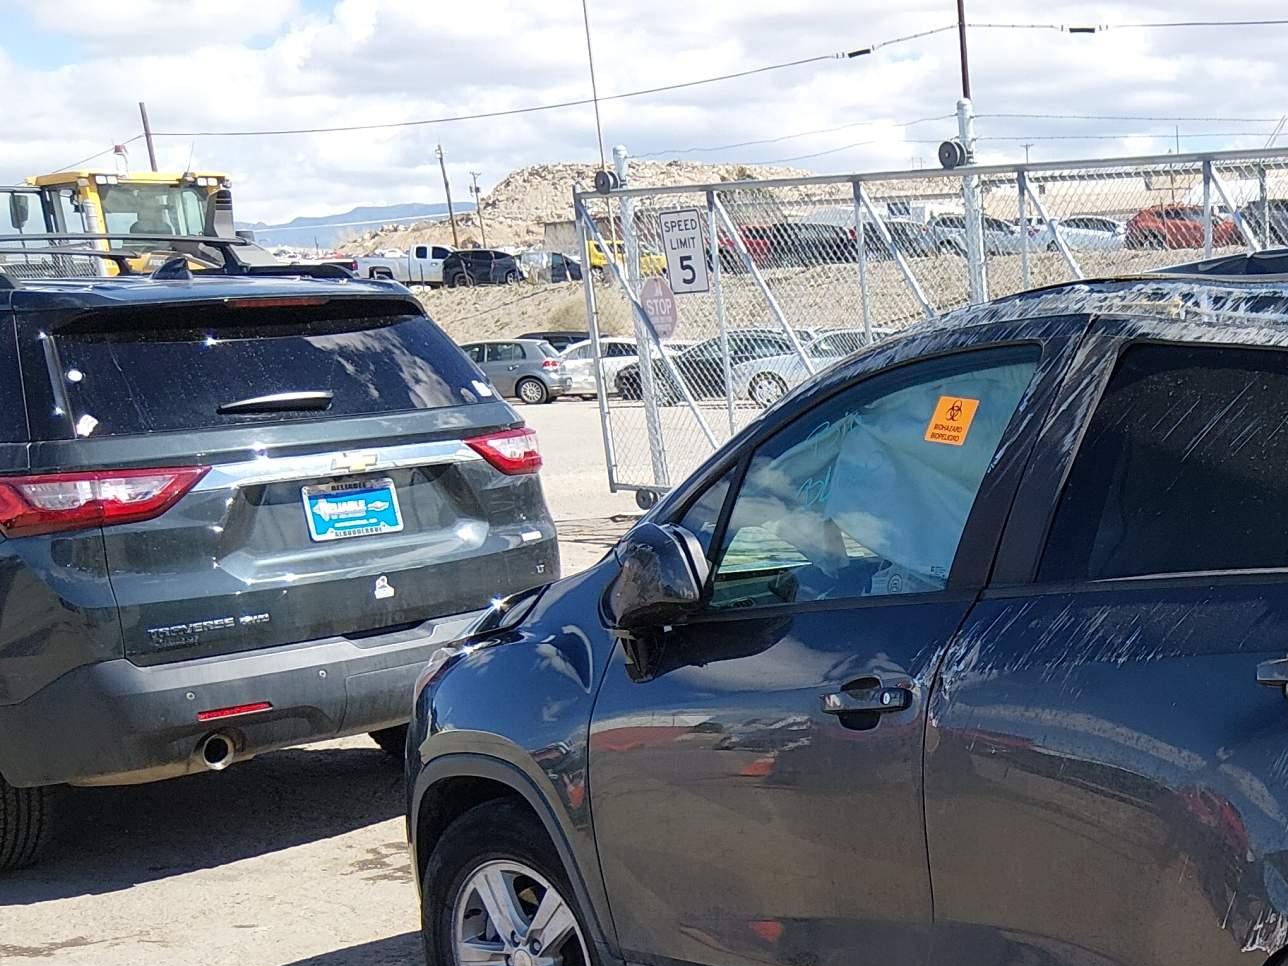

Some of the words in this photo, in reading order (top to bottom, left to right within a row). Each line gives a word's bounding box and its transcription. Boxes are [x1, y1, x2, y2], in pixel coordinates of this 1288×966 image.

[663, 218, 698, 233] SPEED
[669, 236, 696, 250] LIMIT
[679, 255, 696, 285] 5
[646, 298, 672, 315] STOP
[147, 616, 236, 639] TRAVERSE
